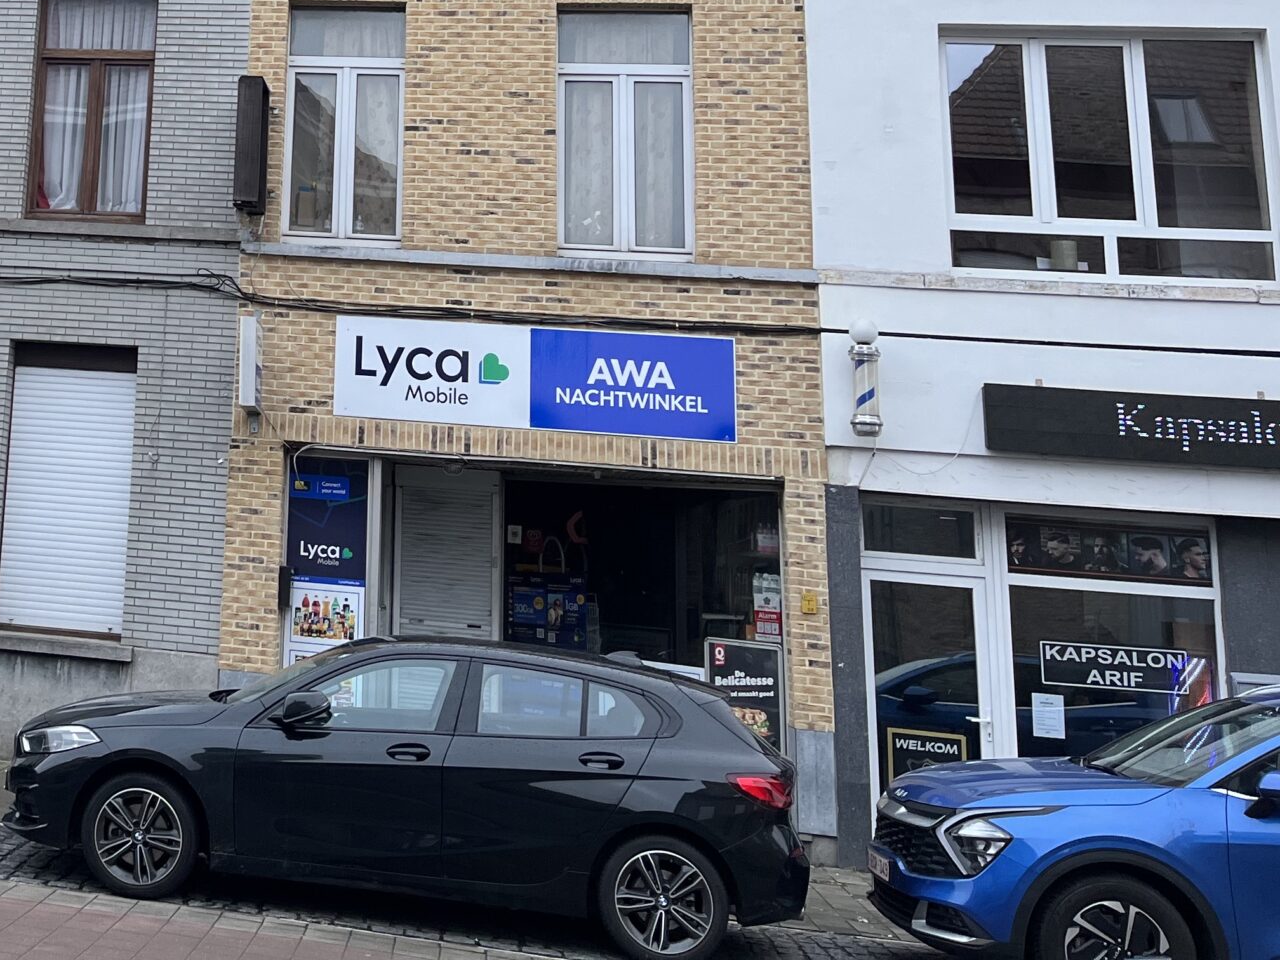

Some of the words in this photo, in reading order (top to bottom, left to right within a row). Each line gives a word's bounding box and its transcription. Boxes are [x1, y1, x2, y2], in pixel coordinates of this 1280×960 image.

[354, 335, 469, 386] Lyca
[586, 357, 676, 390] AWA
[405, 384, 469, 406] Mobile
[555, 388, 709, 414] NACHTWINKEL
[300, 540, 340, 559] Lyca
[317, 558, 340, 566] Mobile
[1045, 645, 1183, 670] KAPSALON
[734, 670, 745, 678] De
[1086, 669, 1144, 687] ARIF
[759, 690, 774, 698] goed
[895, 738, 959, 755] WELKOM
